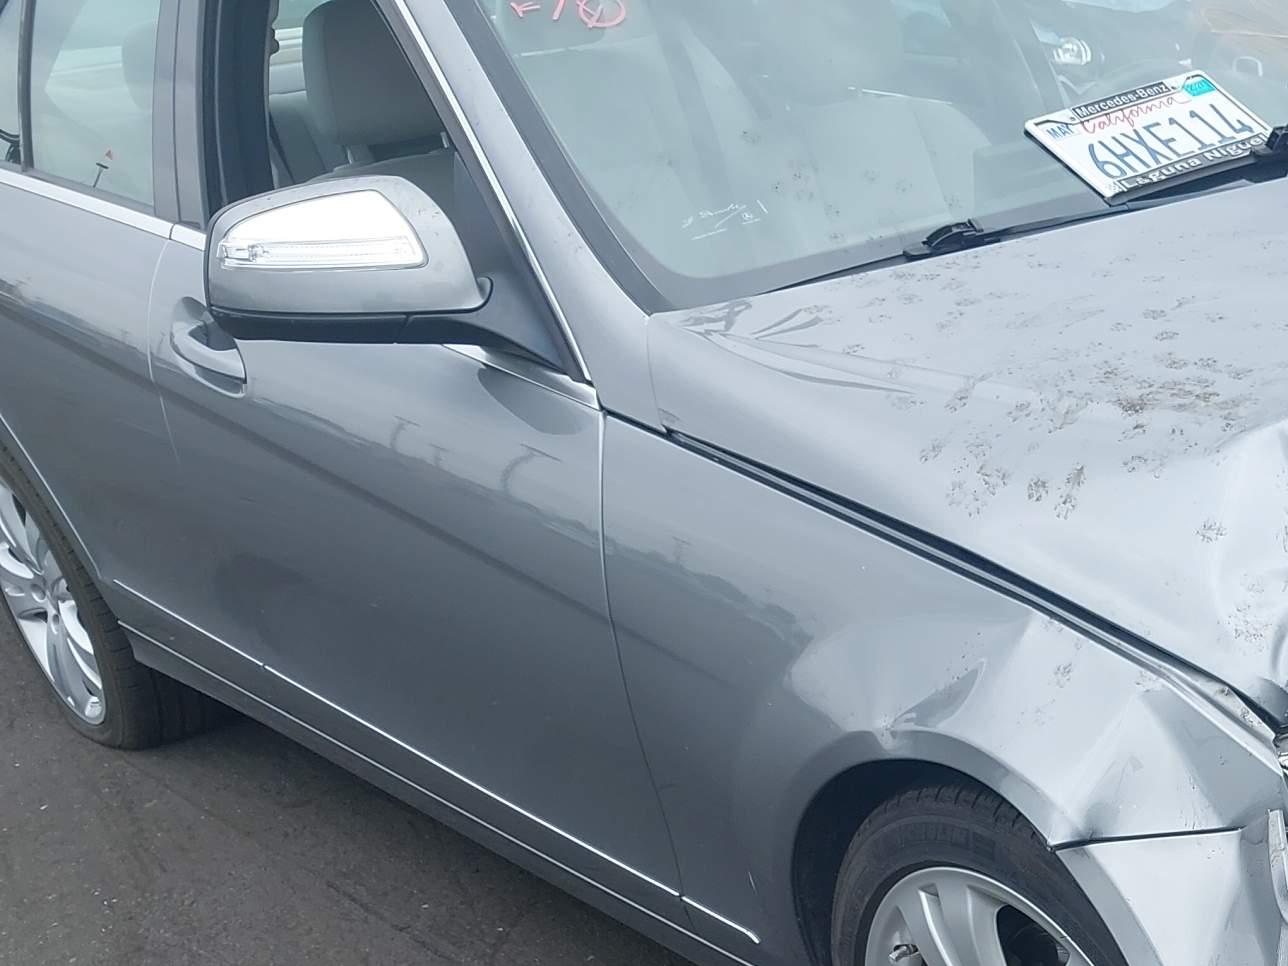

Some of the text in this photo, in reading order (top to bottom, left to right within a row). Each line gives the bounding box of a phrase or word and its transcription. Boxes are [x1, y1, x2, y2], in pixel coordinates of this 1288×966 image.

[1075, 82, 1170, 119] Mercedes-Benz
[1081, 95, 1192, 135] California
[1046, 123, 1074, 140] MAY
[1088, 103, 1256, 180] 6HXE114
[1121, 133, 1267, 190] Laguna Niguel
